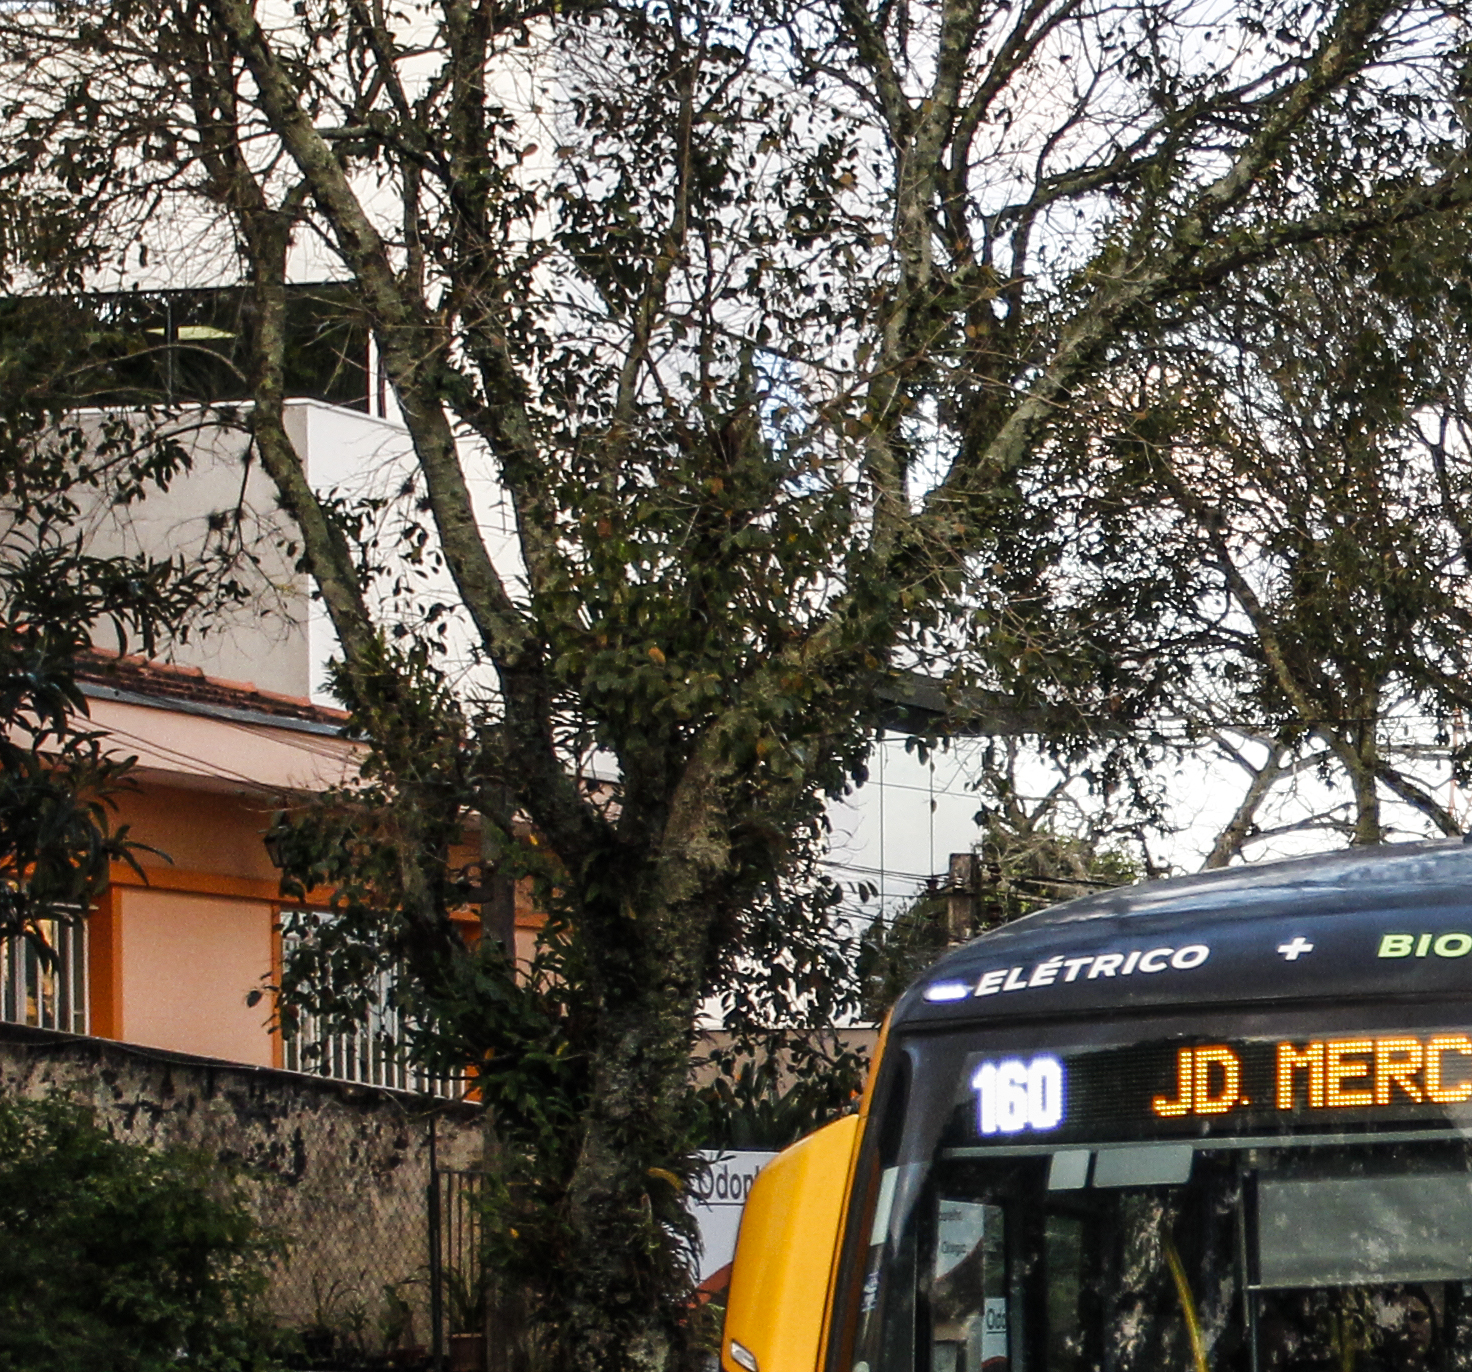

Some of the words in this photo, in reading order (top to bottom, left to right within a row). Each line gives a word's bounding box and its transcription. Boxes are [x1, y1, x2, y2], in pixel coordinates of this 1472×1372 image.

[974, 944, 1210, 997] ELÉTRICO
[972, 1057, 1064, 1136] 160
[1153, 1045, 1251, 1117] JD.
